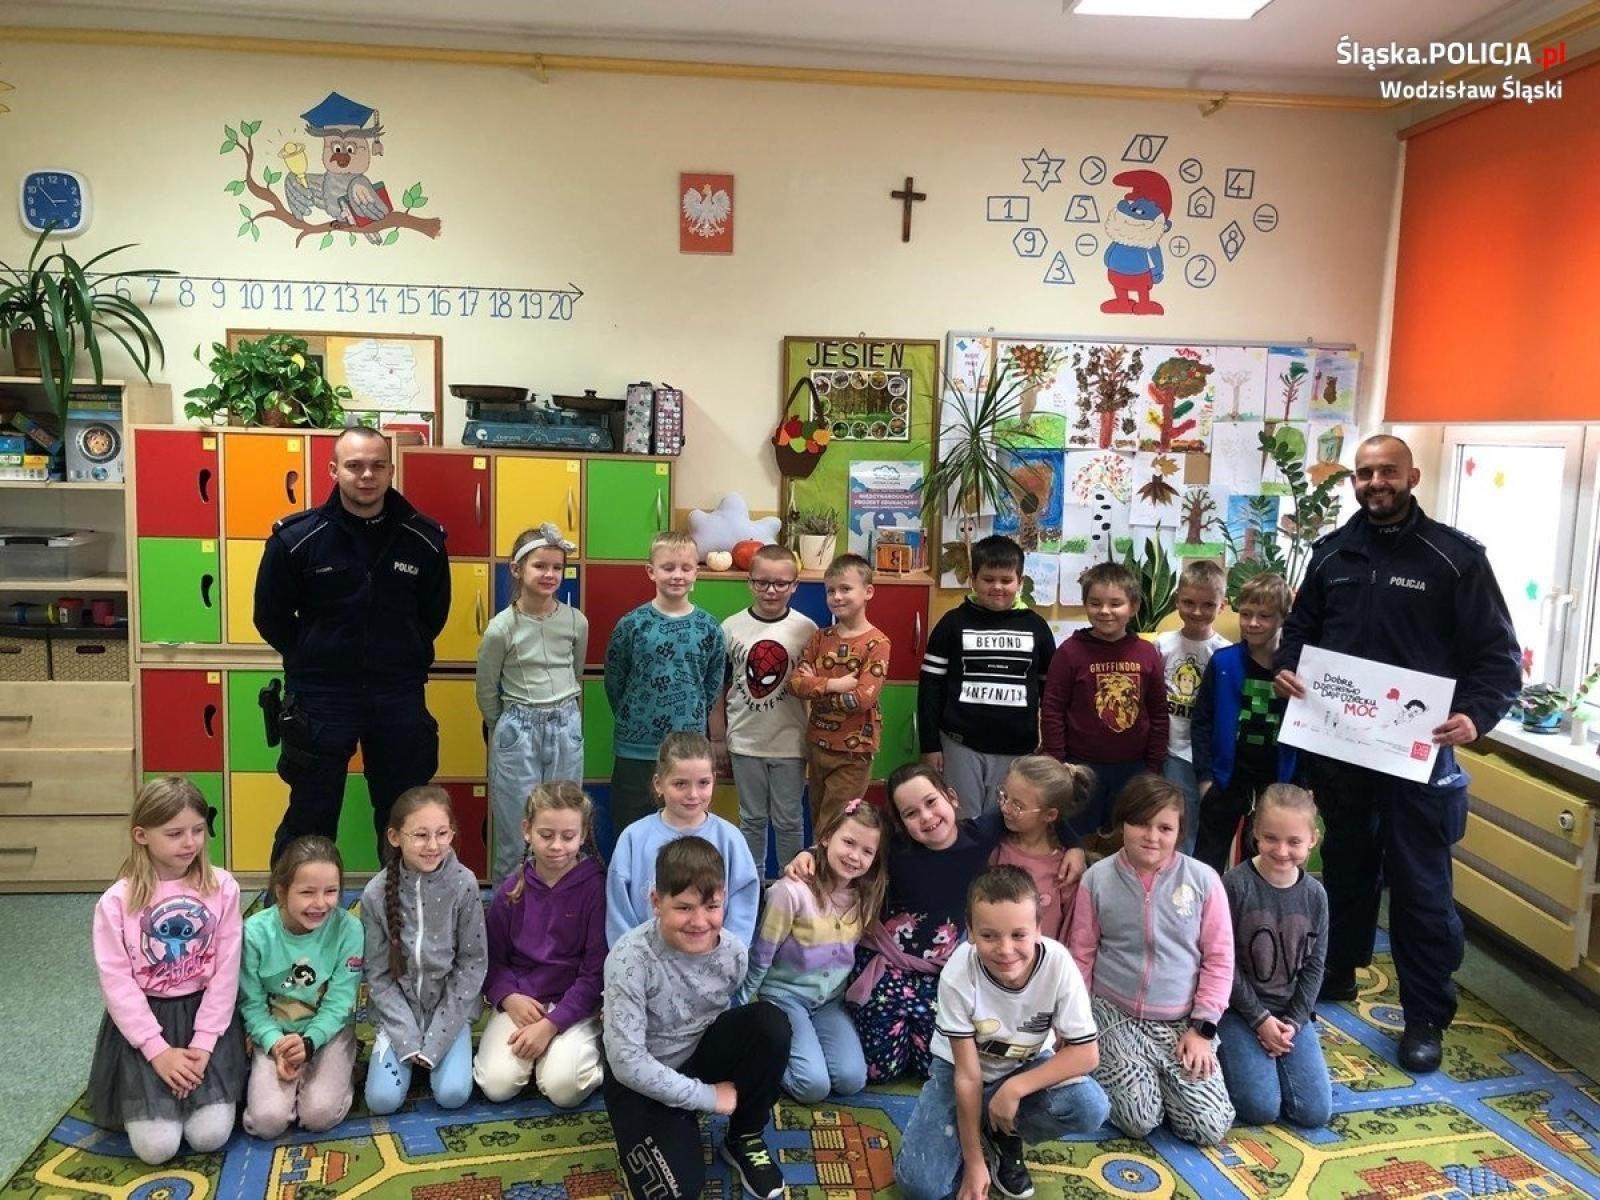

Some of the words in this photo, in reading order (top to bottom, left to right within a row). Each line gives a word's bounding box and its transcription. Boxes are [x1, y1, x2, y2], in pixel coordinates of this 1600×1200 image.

[1138, 135, 1153, 161] 0
[36, 177, 45, 185] 11
[47, 175, 58, 184] 12
[1035, 160, 1051, 182] 7
[28, 186, 37, 194] 10
[71, 186, 77, 195] 2
[1228, 172, 1245, 197] 4
[1002, 198, 1014, 219] 1
[1074, 198, 1090, 220] 5
[1194, 196, 1208, 216] 6
[39, 218, 46, 227] 7
[1023, 230, 1037, 254] 9
[1225, 229, 1238, 253] 8
[1052, 259, 1066, 281] 3
[1194, 258, 1209, 281] 2
[146, 278, 160, 305] 7
[179, 279, 195, 308] 8
[211, 280, 226, 309] 9
[239, 282, 265, 310] 10
[272, 283, 293, 311] 11
[303, 284, 326, 312] 12
[334, 285, 360, 313] 13
[366, 287, 388, 314] 14
[397, 288, 420, 315] 15
[428, 289, 452, 317] 16
[458, 290, 480, 317] 17
[489, 291, 513, 319] 18
[519, 292, 542, 320] 19
[548, 292, 574, 321] 20
[1390, 576, 1426, 591] POLICJA
[976, 636, 1021, 649] BEYOND
[1090, 661, 1141, 673] GRYFFINDOR
[965, 685, 1023, 702] INFINITY
[1343, 703, 1379, 718] MOC
